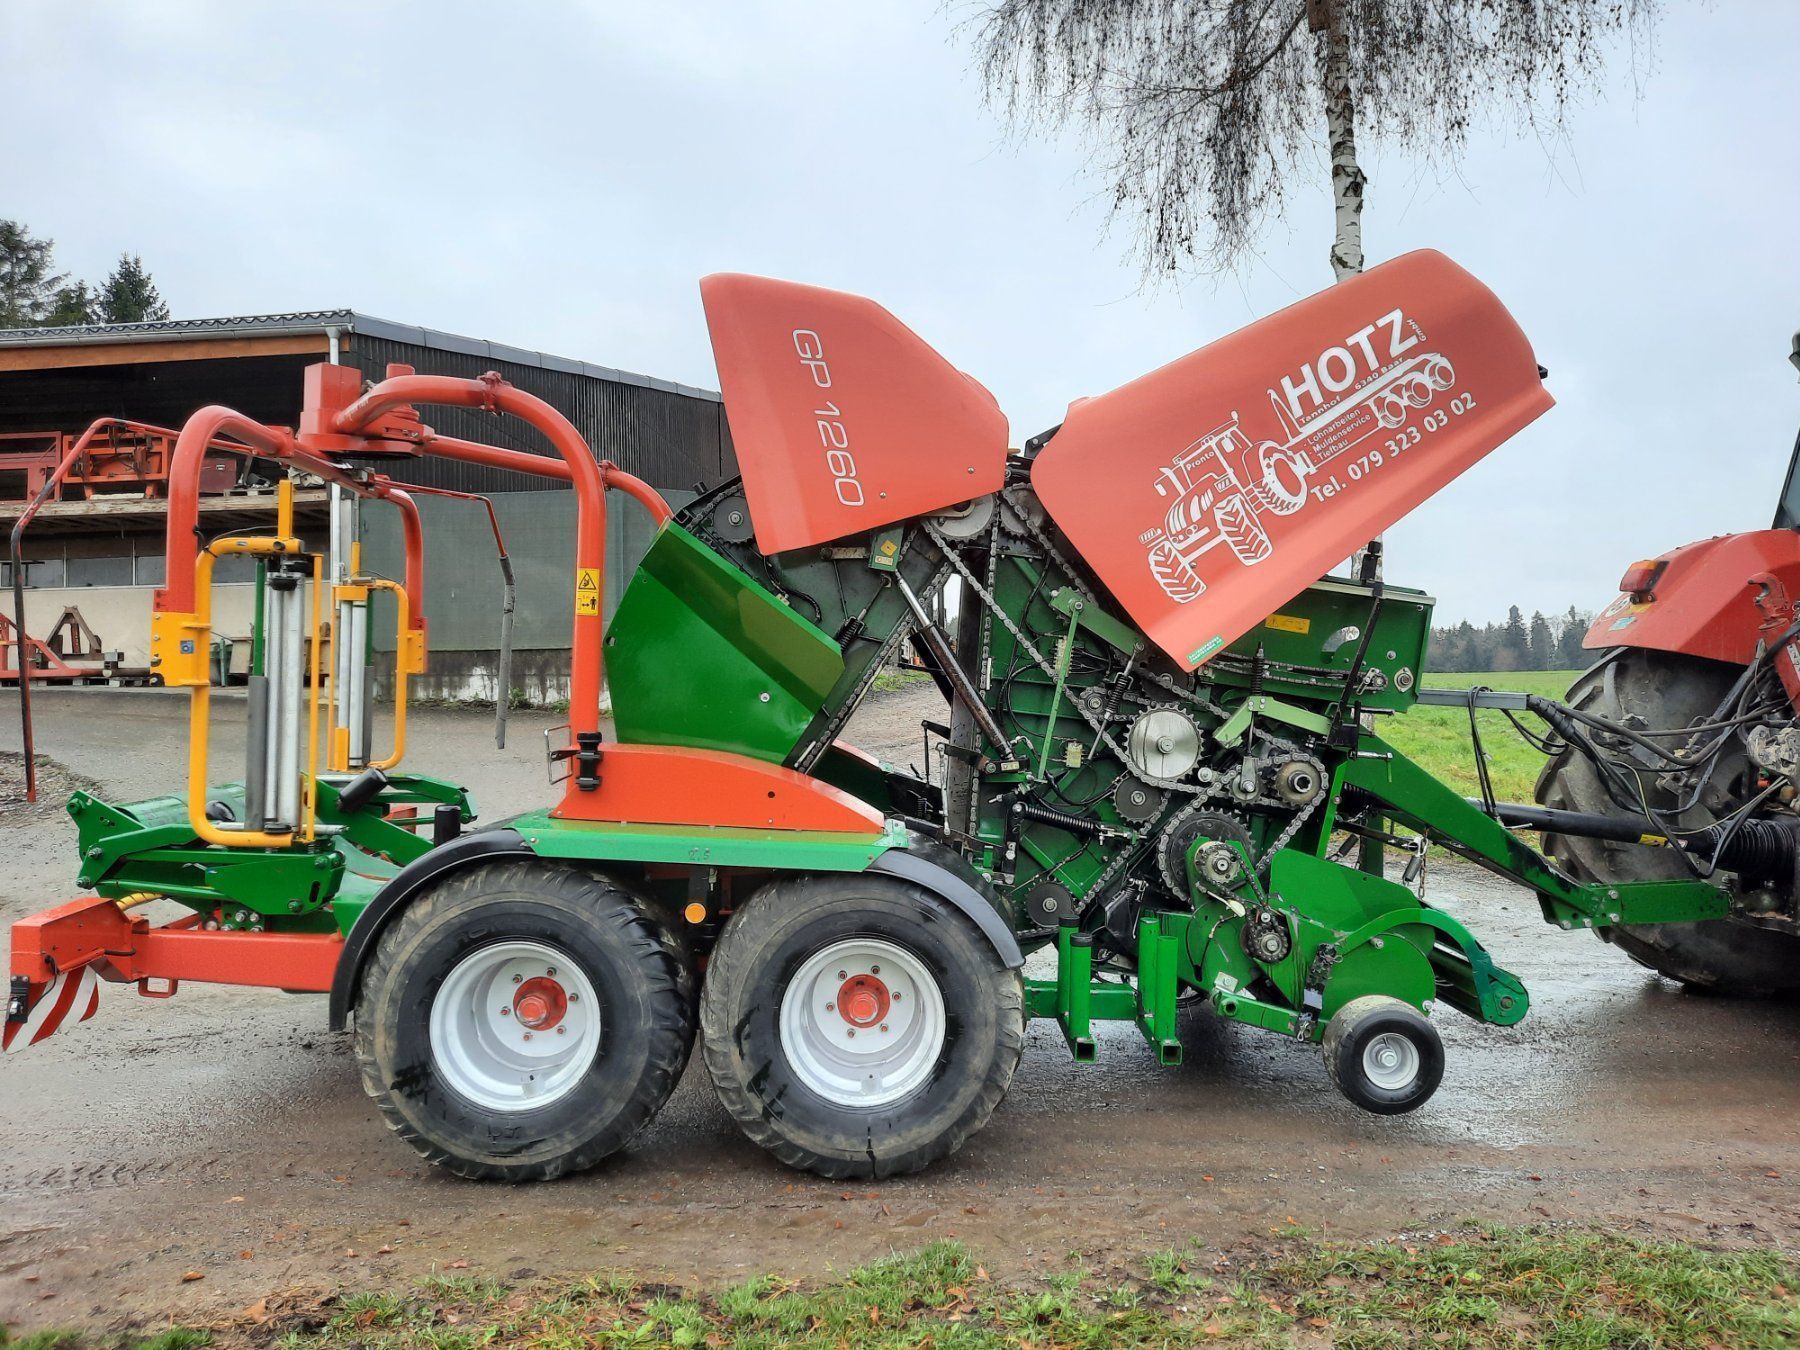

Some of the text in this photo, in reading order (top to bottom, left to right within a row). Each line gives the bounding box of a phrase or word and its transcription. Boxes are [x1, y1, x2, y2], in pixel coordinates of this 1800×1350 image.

[1406, 319, 1427, 342] GmbH
[1280, 308, 1418, 418] HOTZ
[1299, 357, 1404, 424] Tannhof 6340 Baar
[793, 329, 864, 507] GP 1260
[1307, 409, 1361, 445] Lohnarbeiten
[1313, 414, 1371, 453] Muldenservice
[1186, 451, 1215, 471] Pronto
[1311, 392, 1476, 502] Tel. 079 323 03 02
[1317, 439, 1349, 461] Tiefbau
